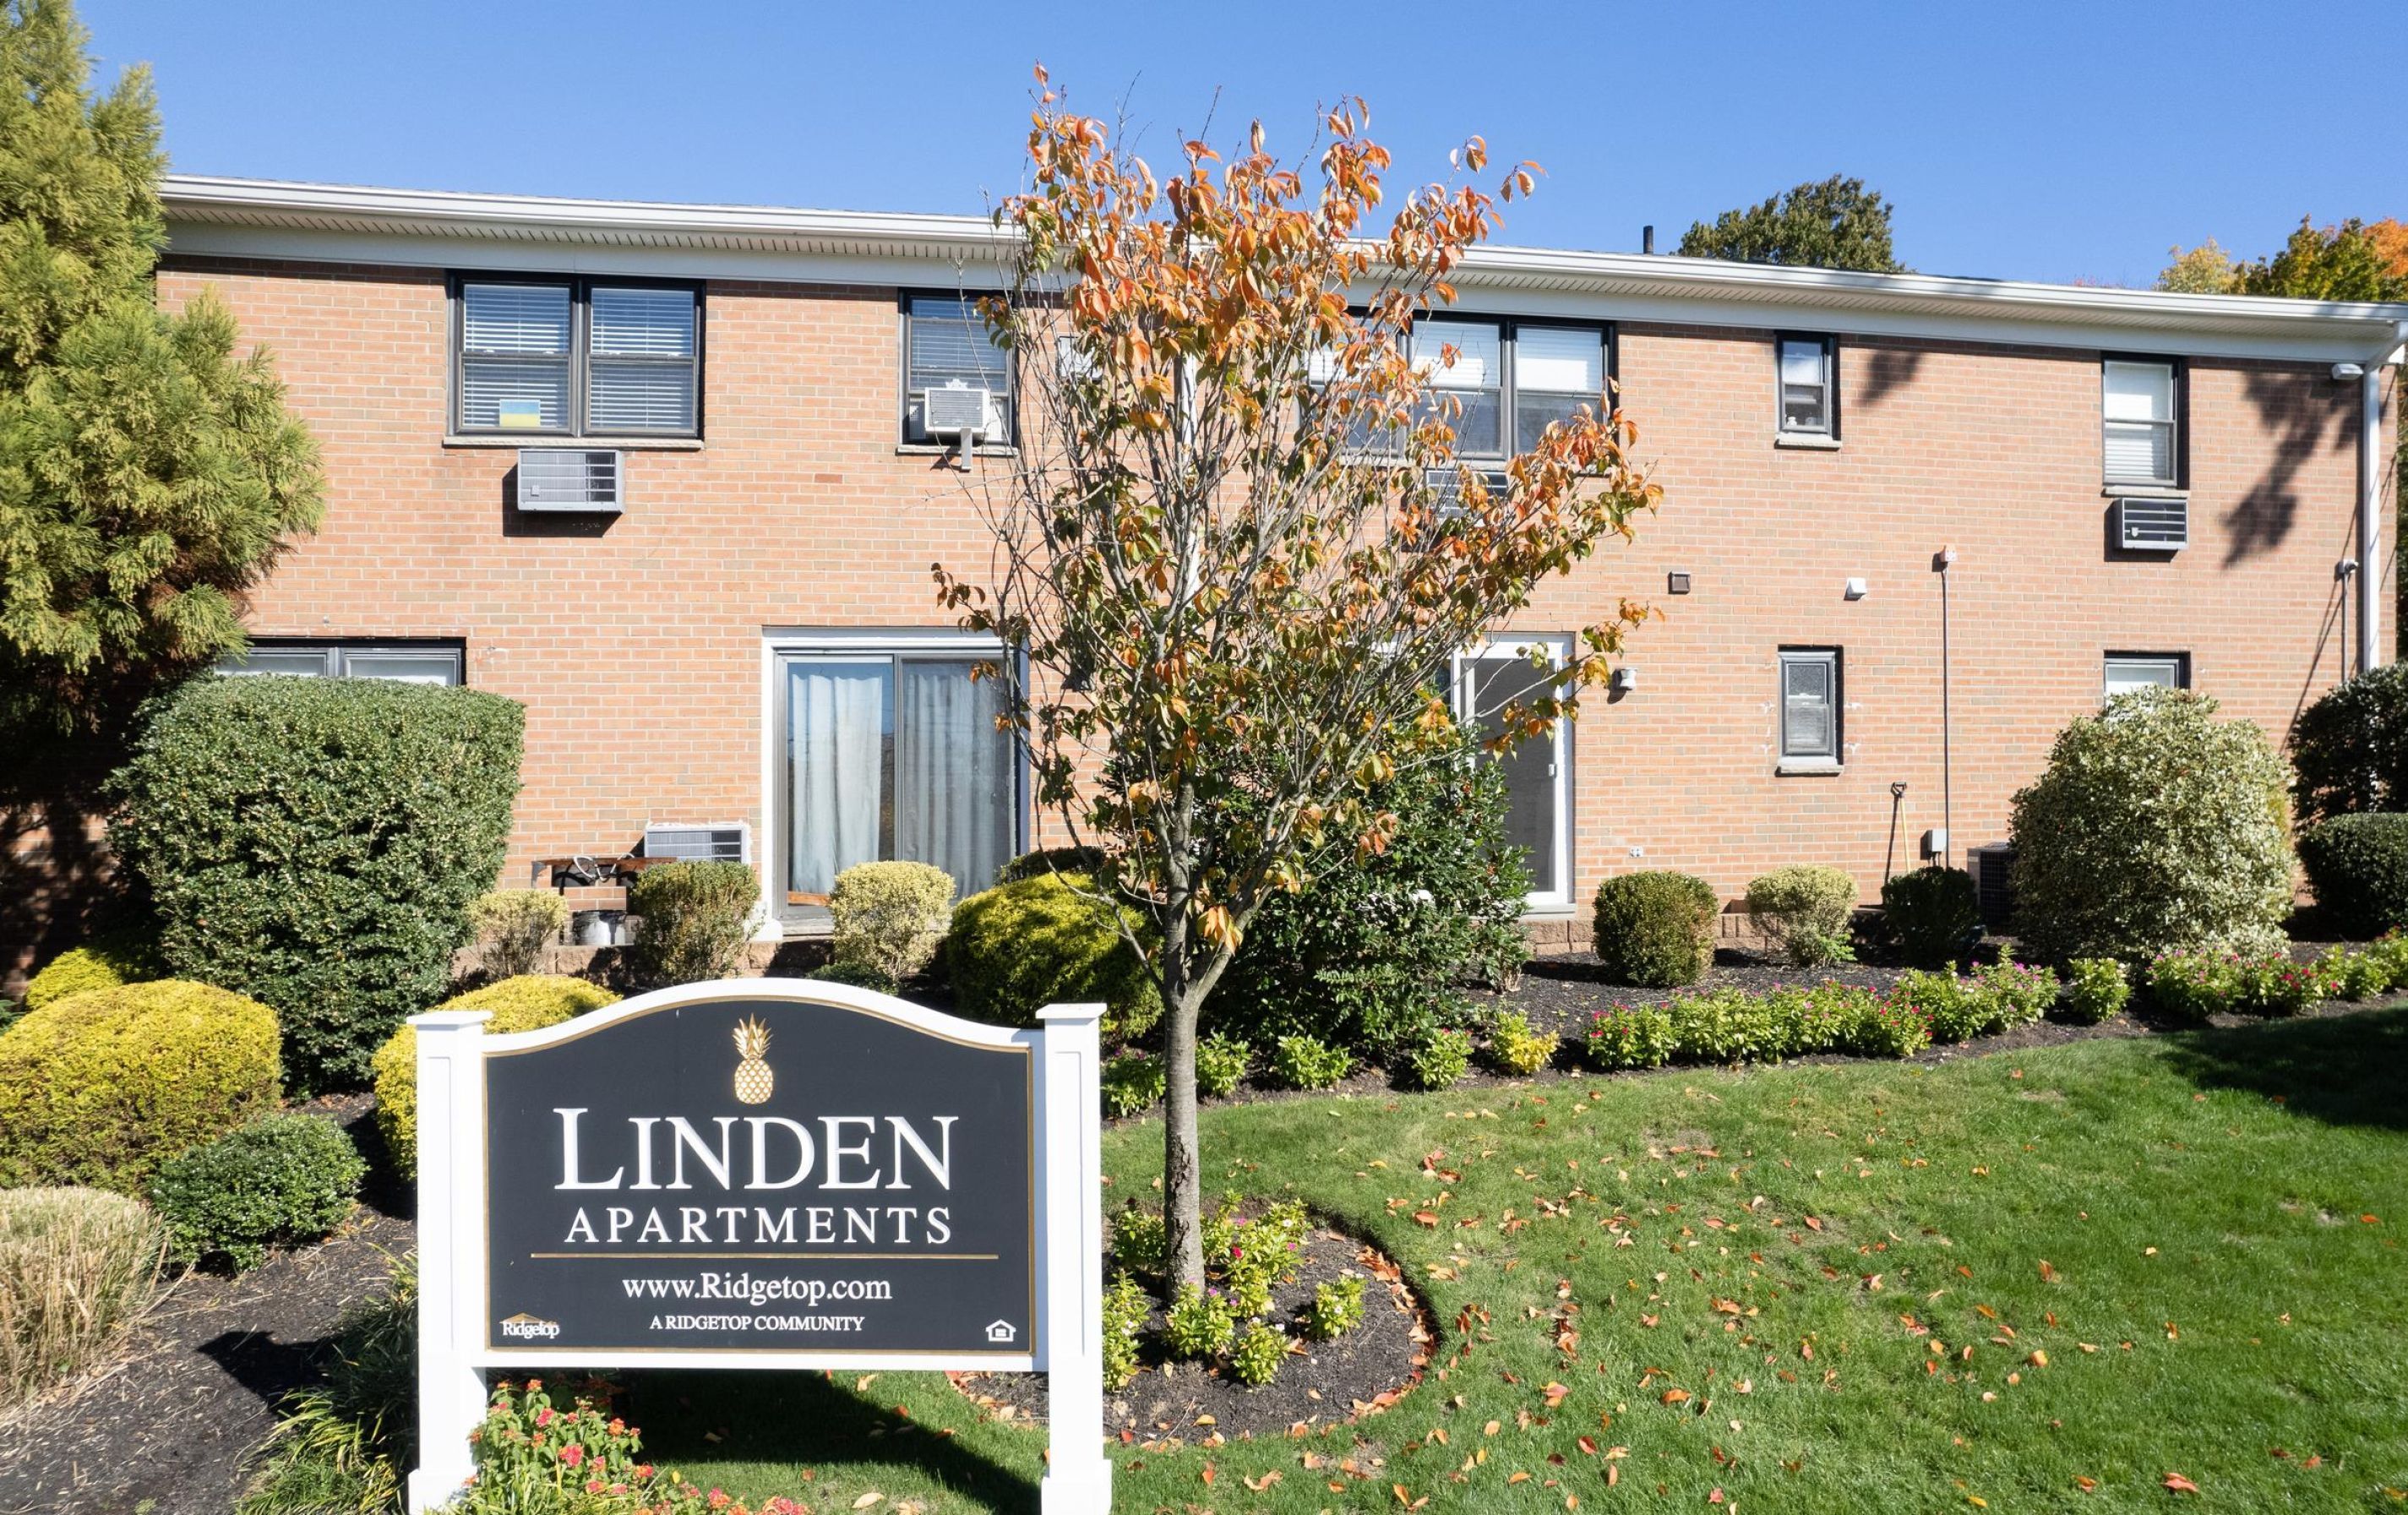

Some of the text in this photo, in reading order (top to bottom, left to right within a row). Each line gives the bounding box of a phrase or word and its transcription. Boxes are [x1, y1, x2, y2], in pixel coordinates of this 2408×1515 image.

[553, 1108, 959, 1190] LINDEN
[564, 1207, 951, 1244] APARTMENTS
[622, 1272, 893, 1307] www.Ridgetop.com
[502, 1320, 561, 1339] Ridgetop
[649, 1315, 866, 1332] A RIDGETOP COMMUNITY
